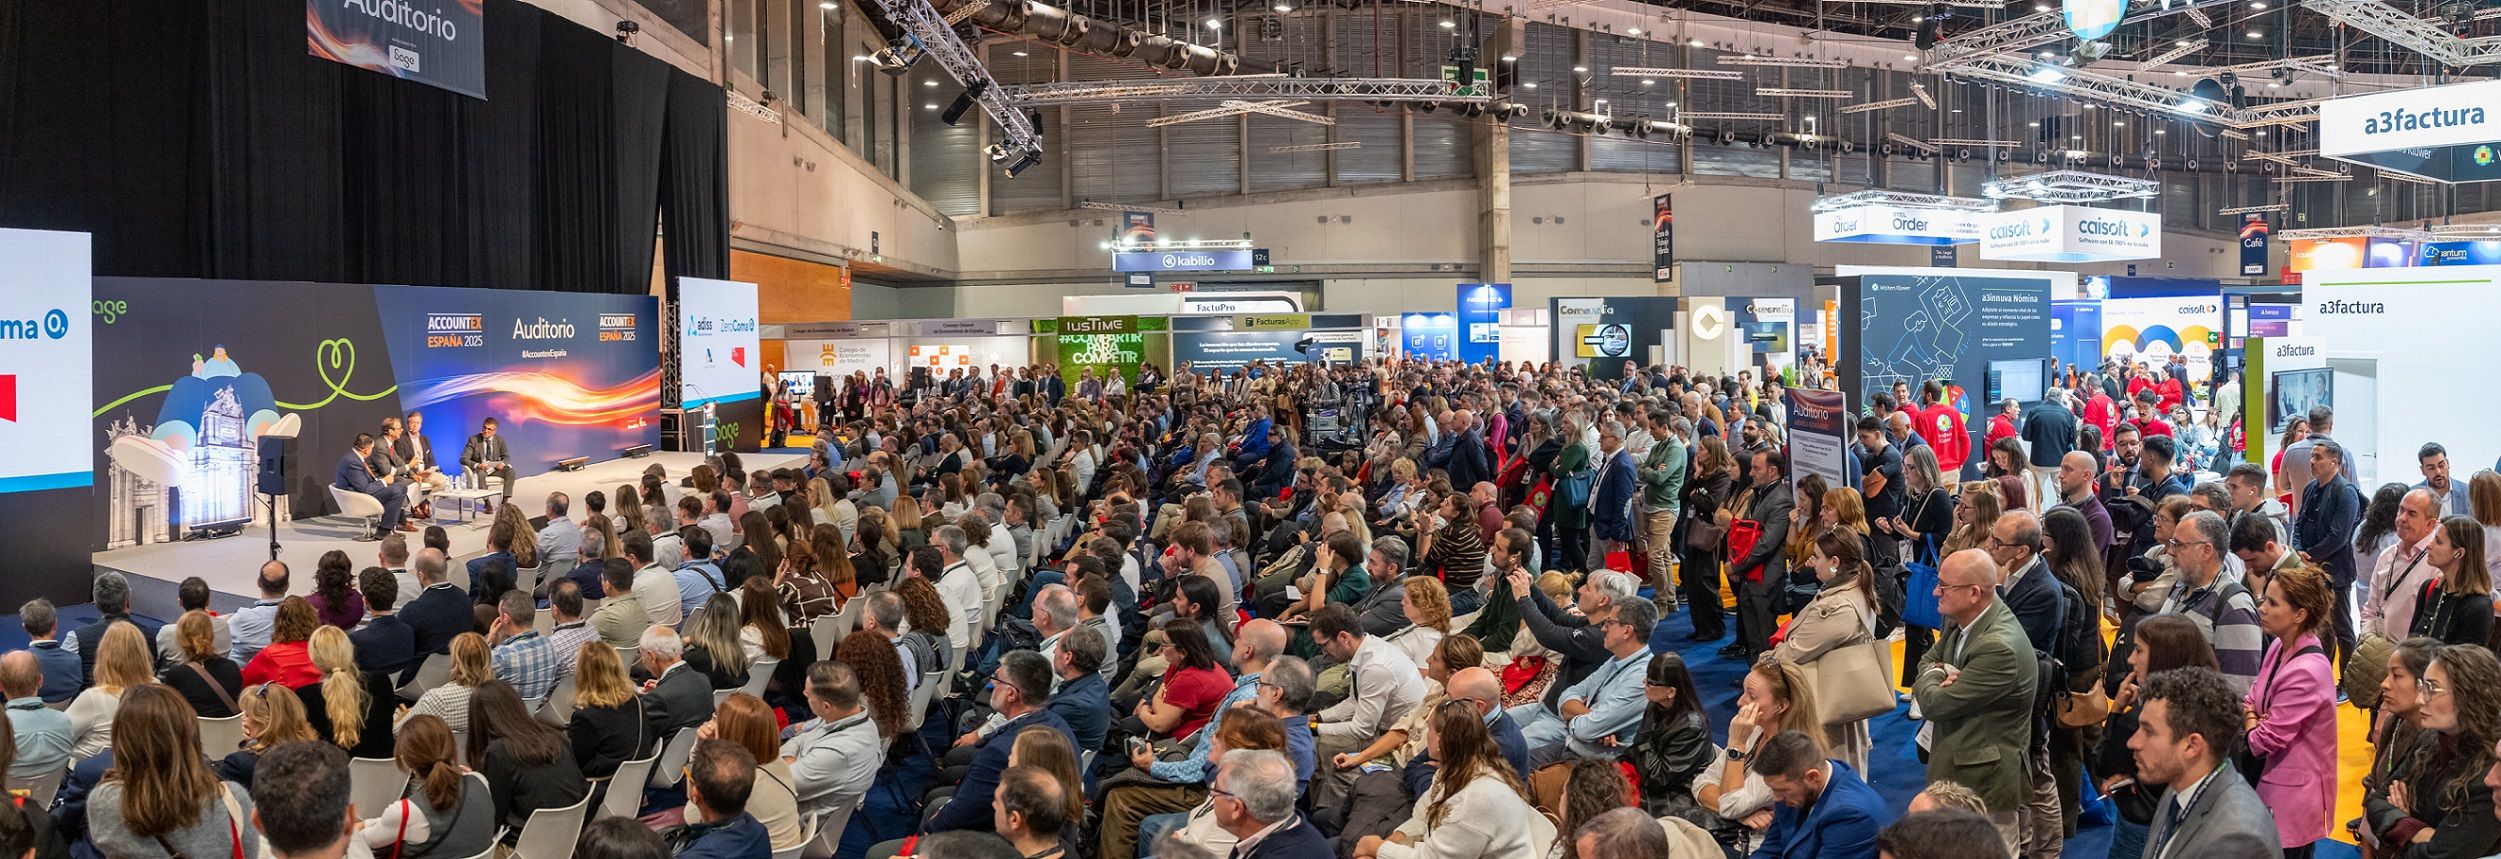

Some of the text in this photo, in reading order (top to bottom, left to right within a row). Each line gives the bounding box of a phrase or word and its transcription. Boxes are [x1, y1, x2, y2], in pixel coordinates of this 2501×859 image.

[393, 48, 415, 68] Sage
[2364, 106, 2485, 135] a3factura
[1833, 220, 1857, 234] Order
[1892, 217, 1929, 231] Order
[1990, 219, 2032, 240] caisoft
[2078, 217, 2129, 237] caisoft
[2244, 237, 2263, 248] Café
[1177, 255, 1215, 267] kabilio
[1254, 253, 1267, 262] 12c
[1982, 293, 2038, 303] a3innuva Nómina
[92, 300, 127, 325] age
[1197, 304, 1236, 312] FactuPro
[2178, 304, 2206, 315] caisoft
[2319, 300, 2384, 314] a3factura
[428, 316, 482, 330] ACCOUNTEX
[512, 317, 575, 339] Auditorio
[599, 316, 636, 327] ACCOUNTEX
[698, 316, 712, 331] adiss
[1256, 317, 1299, 327] FacturasApp
[428, 333, 483, 348] ESPAÑA 2025
[599, 331, 636, 341] ESPAÑA 2025
[1059, 333, 1143, 344] #COMPARTIR
[522, 349, 567, 359] #AccountexEspaña
[1087, 340, 1120, 354] PARA
[2277, 344, 2315, 357] a3factura
[1072, 351, 1138, 363] COMPETIR
[1793, 401, 1829, 420] Auditorio
